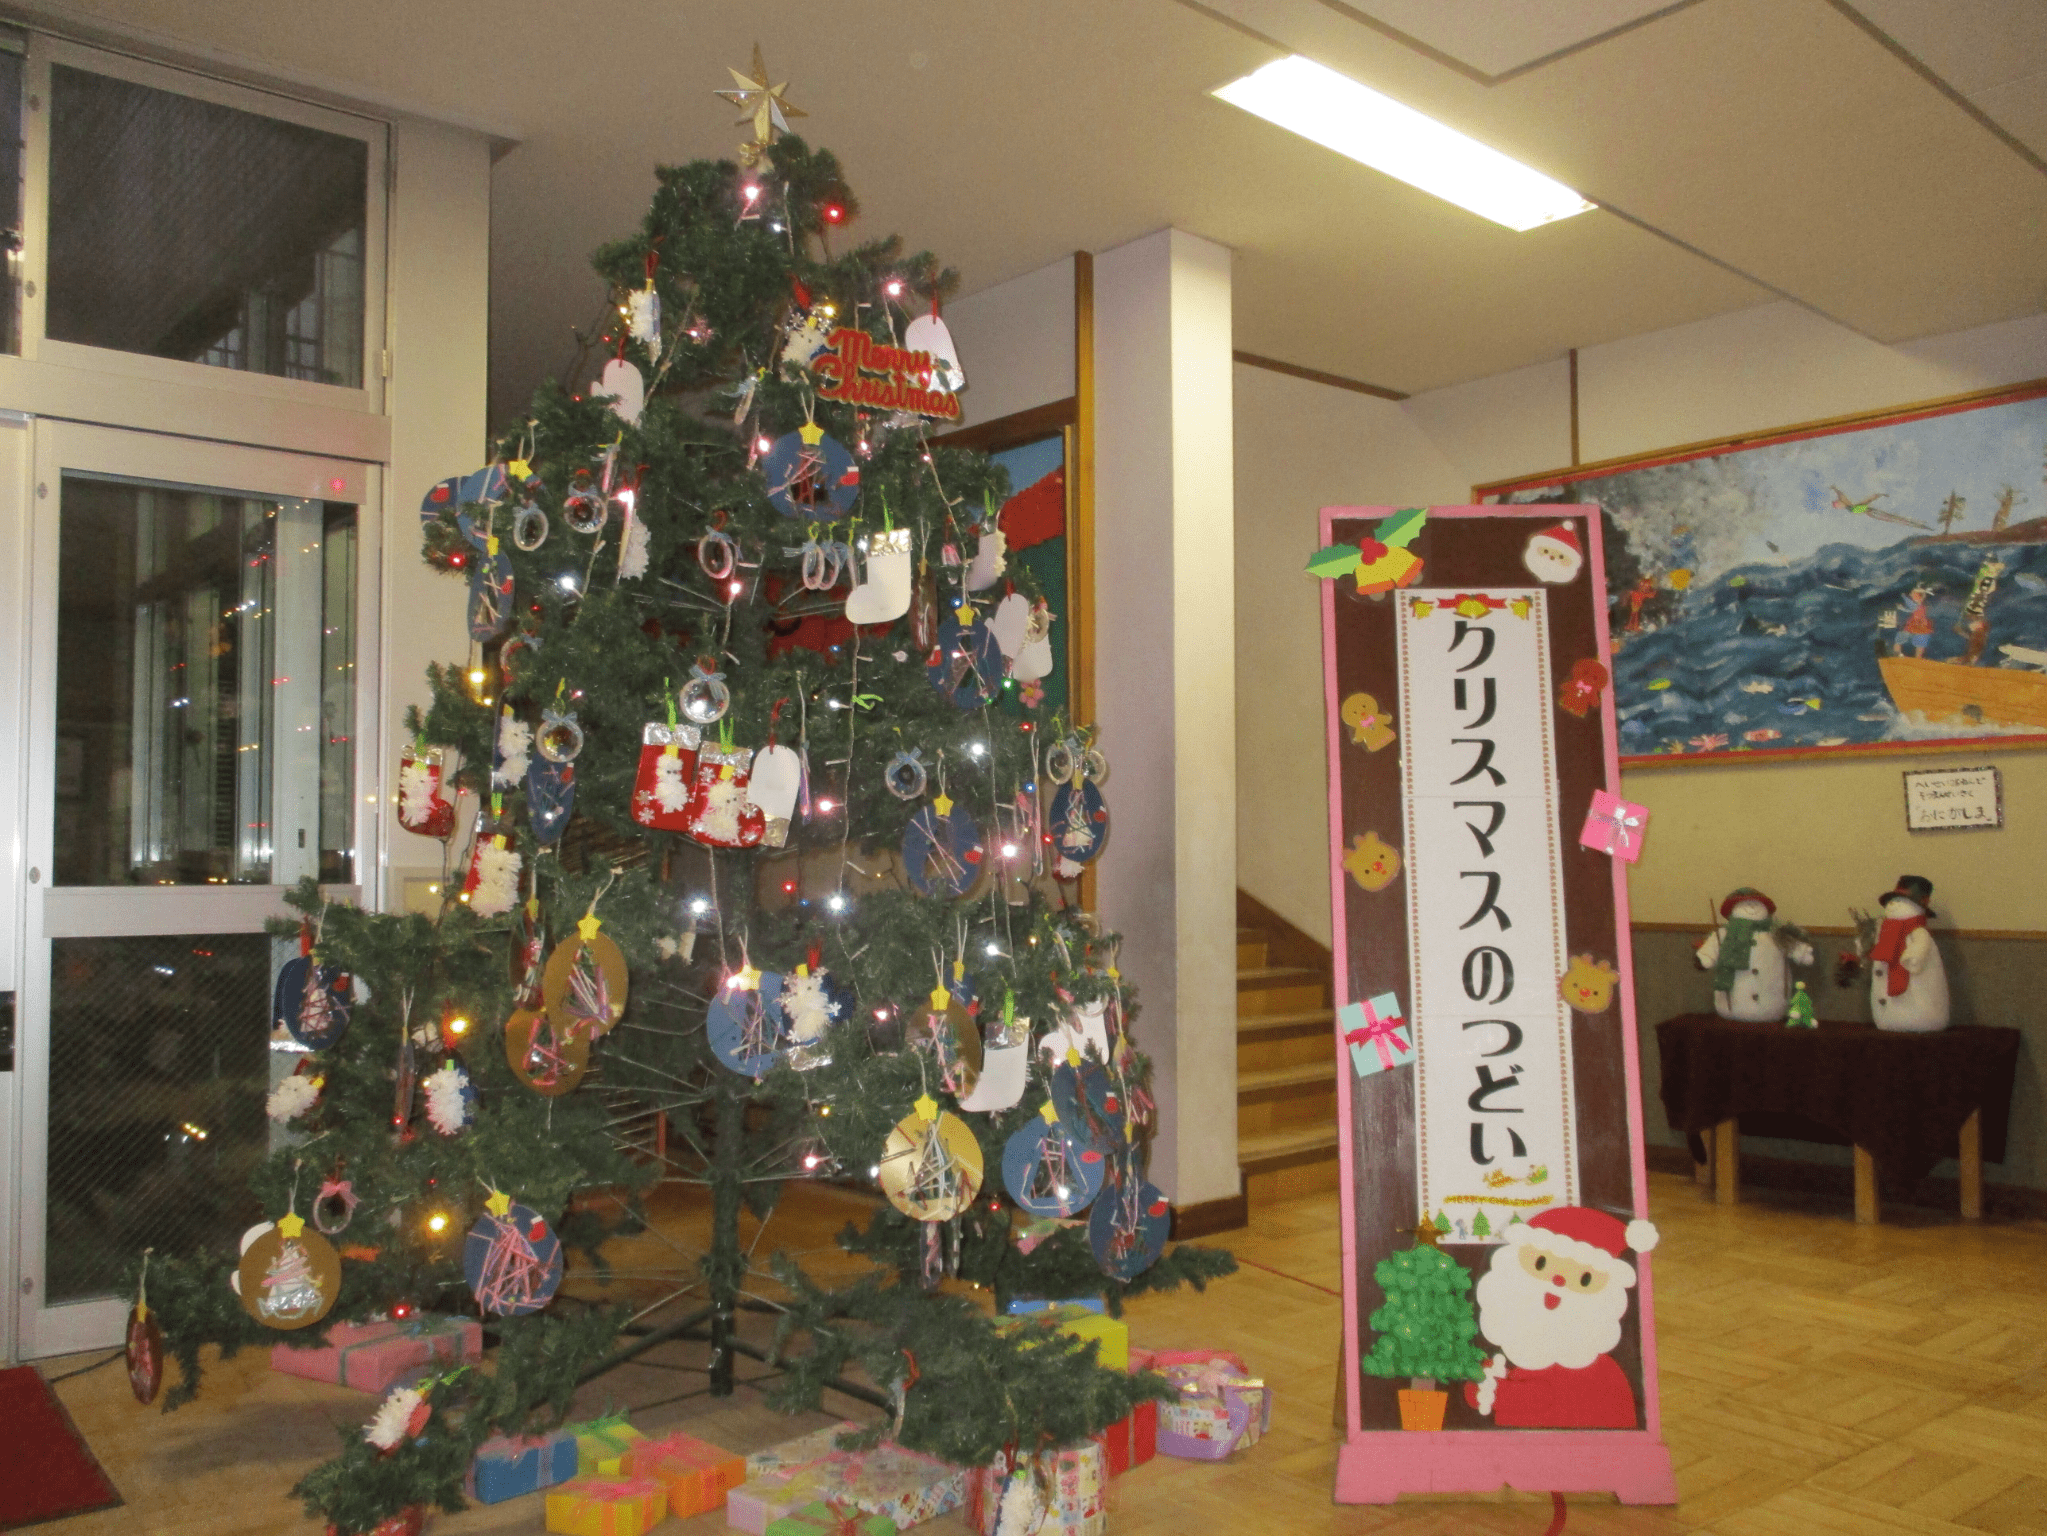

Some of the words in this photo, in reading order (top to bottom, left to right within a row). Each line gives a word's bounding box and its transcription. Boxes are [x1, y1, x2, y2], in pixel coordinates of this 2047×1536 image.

[812, 352, 960, 421] Christmas
[825, 327, 934, 384] Merry
[1447, 619, 1528, 1168] クリスマスのつどい
